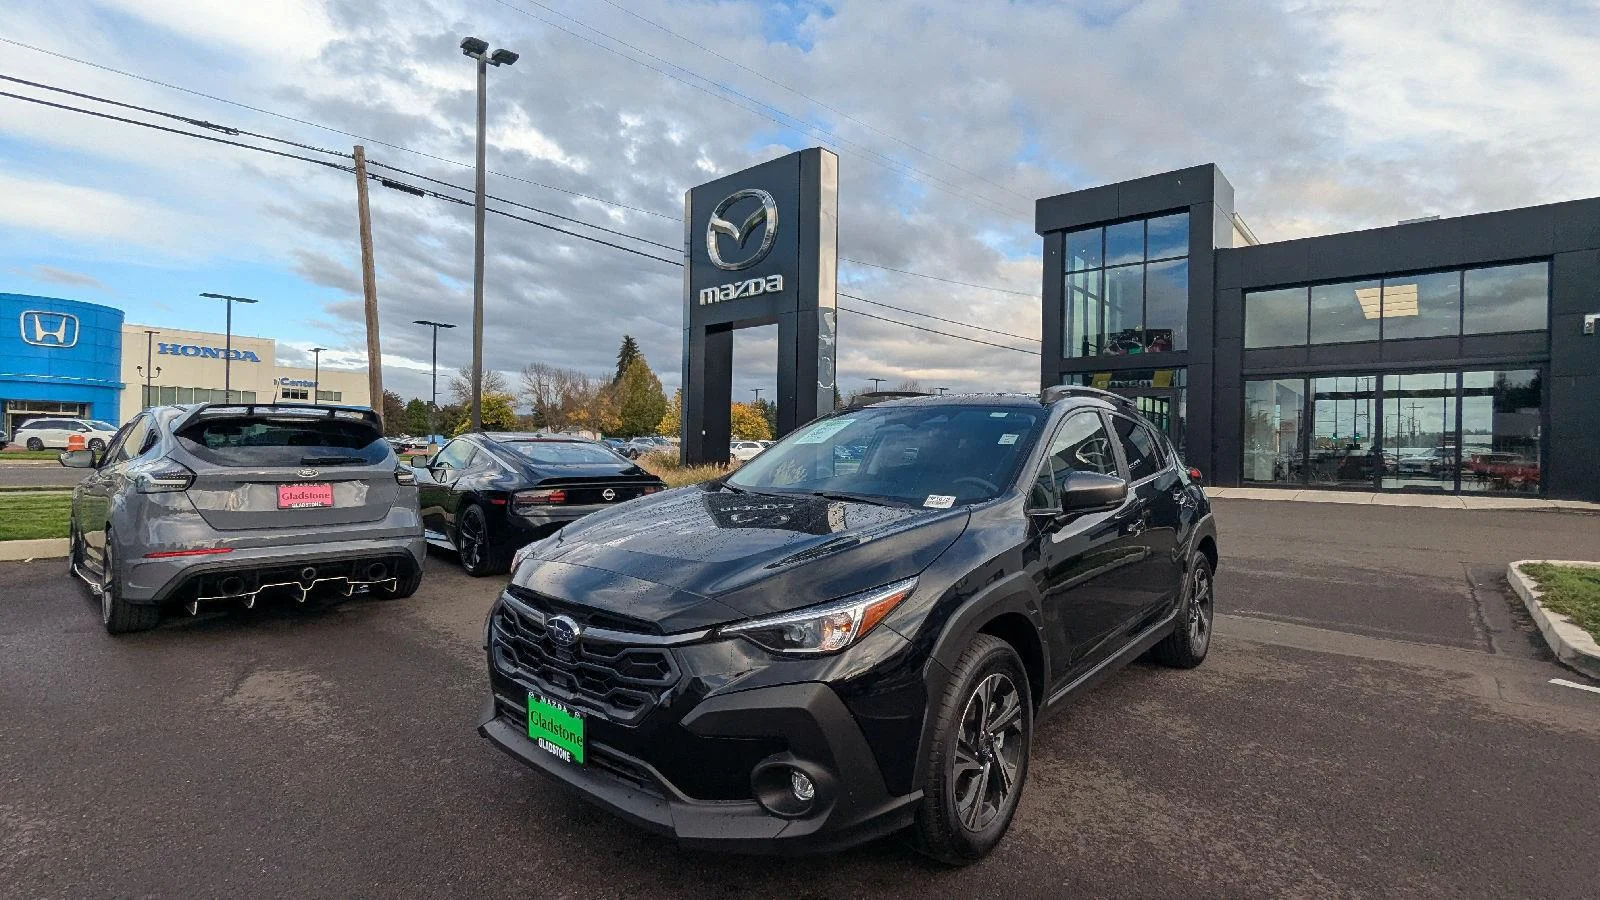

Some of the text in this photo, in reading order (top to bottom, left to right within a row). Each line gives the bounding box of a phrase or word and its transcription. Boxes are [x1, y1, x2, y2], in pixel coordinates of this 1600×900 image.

[699, 274, 784, 306] mazda
[157, 342, 261, 363] HONDA
[281, 491, 331, 501] Gladstone
[540, 695, 568, 712] MAZDA
[530, 710, 583, 748] Gladstone
[538, 737, 571, 763] GLADSTONE
